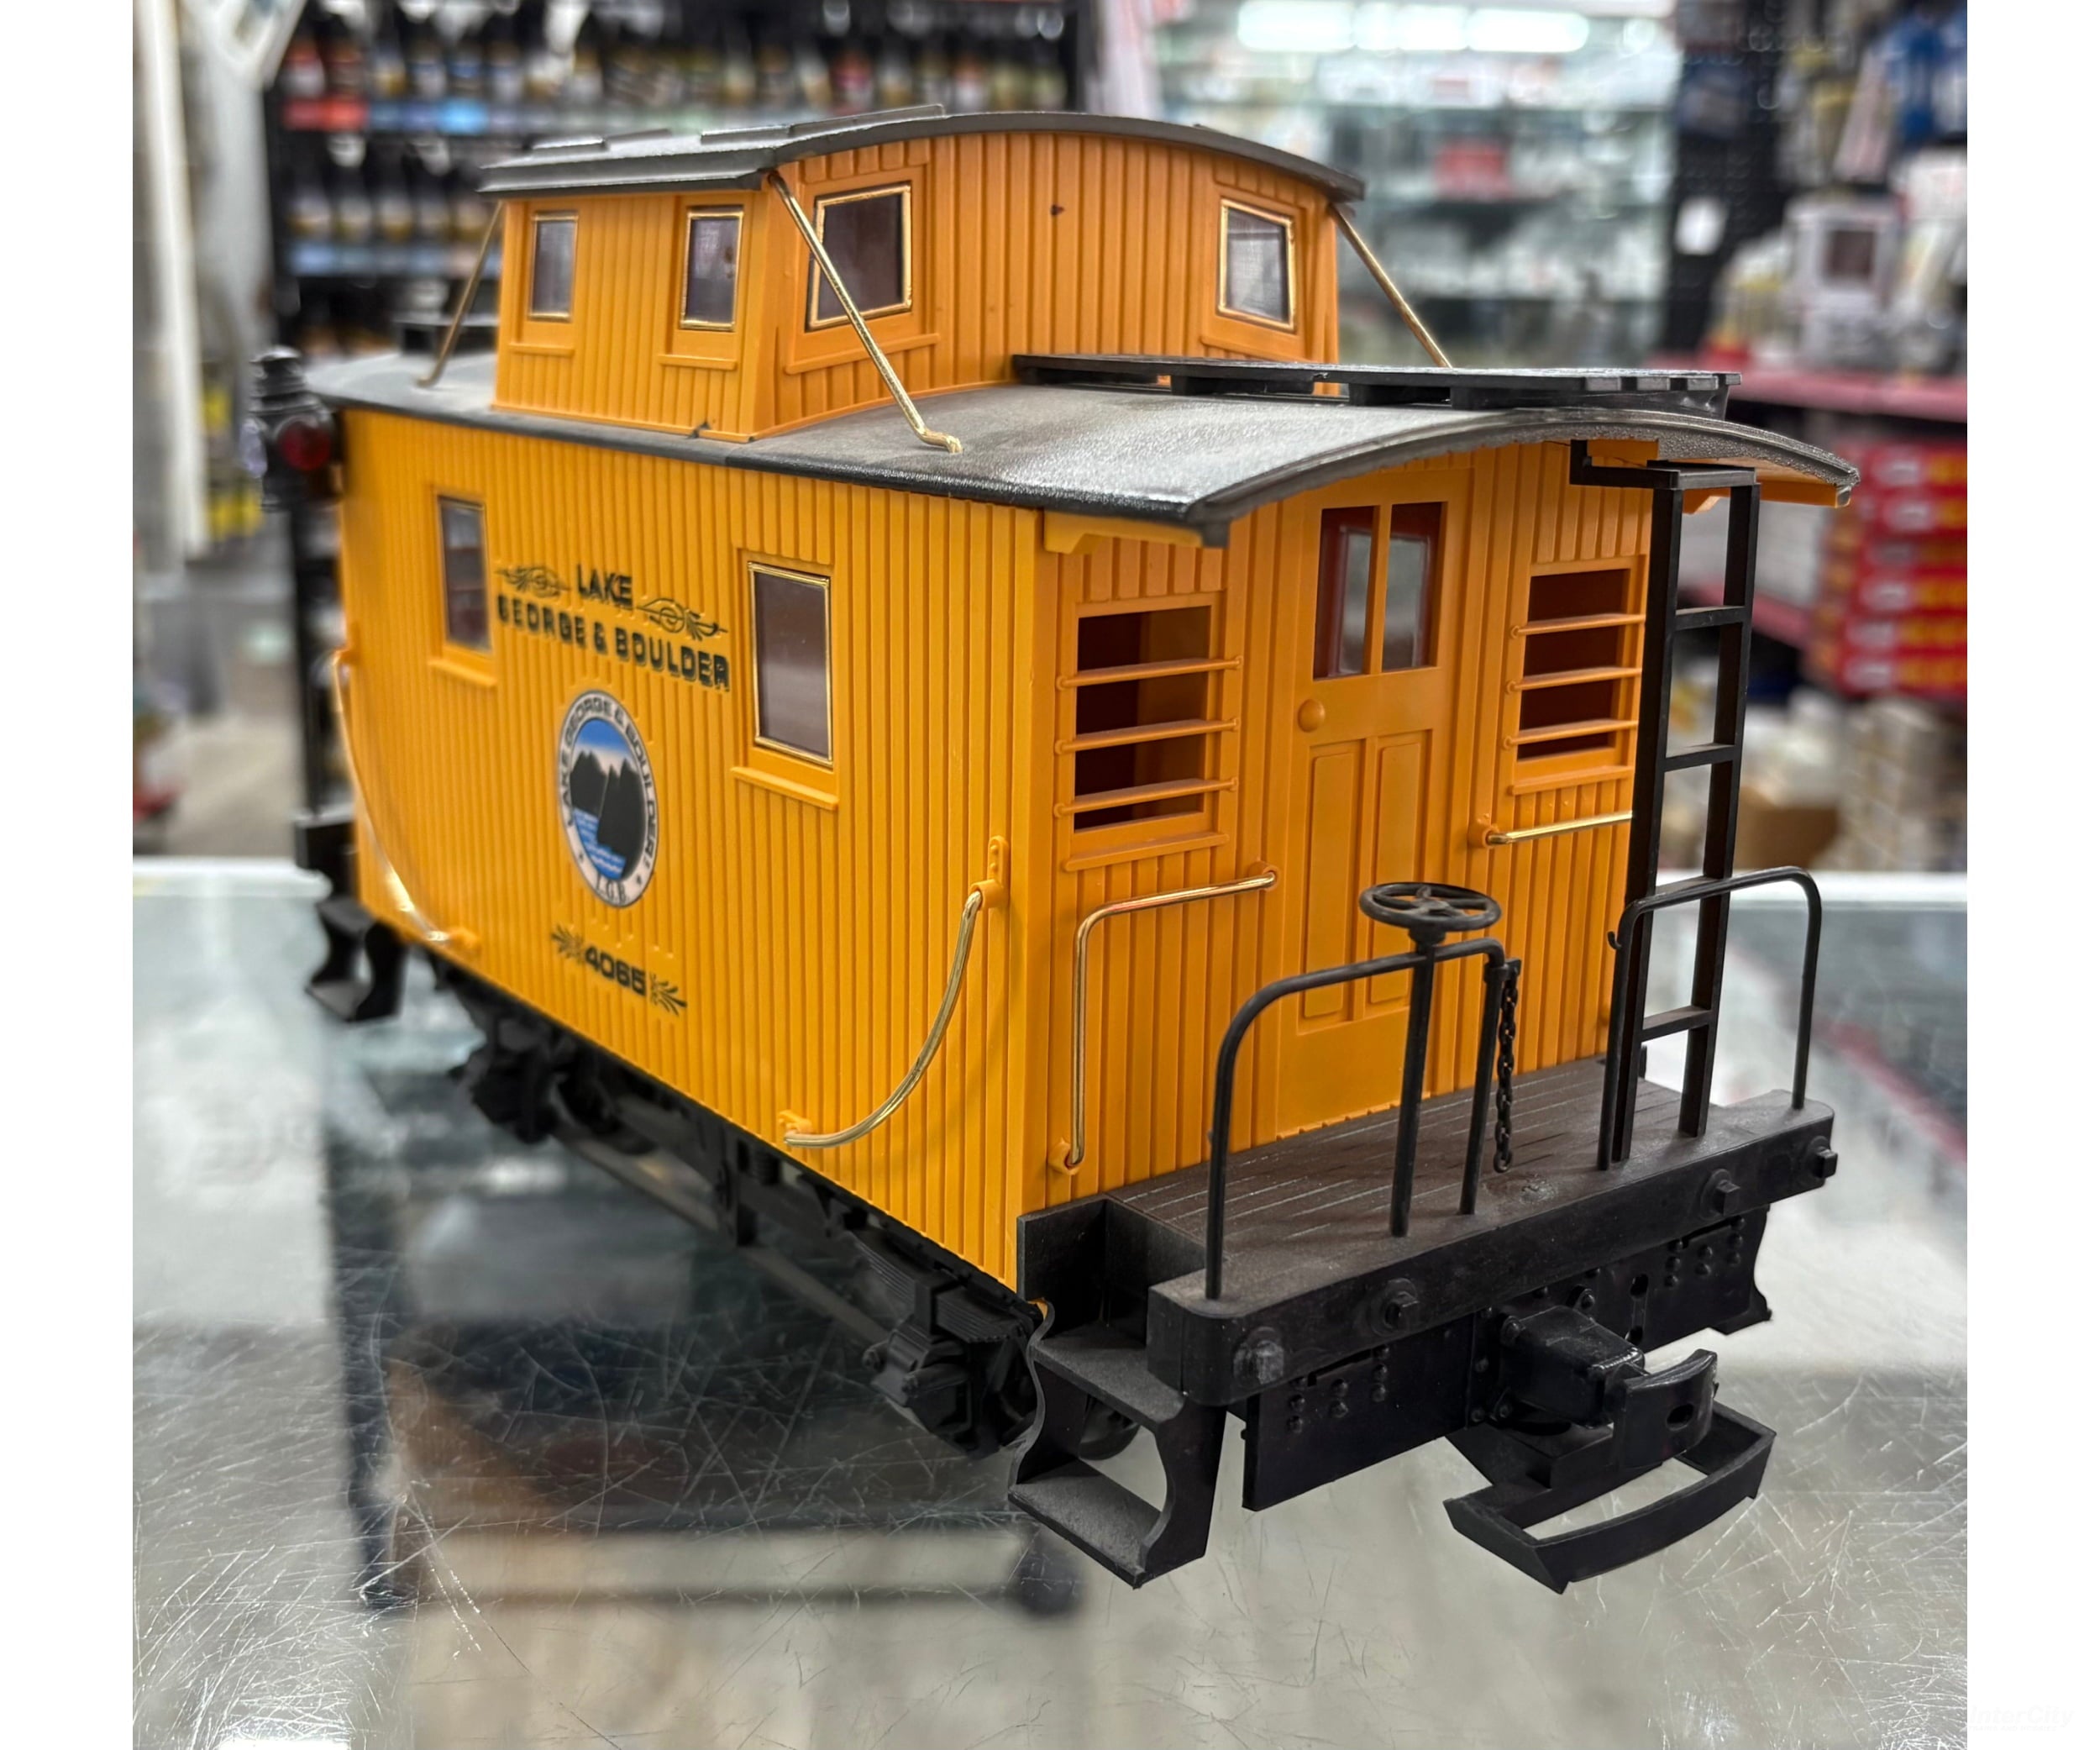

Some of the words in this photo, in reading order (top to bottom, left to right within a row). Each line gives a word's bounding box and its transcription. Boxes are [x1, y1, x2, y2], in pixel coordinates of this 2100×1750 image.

[577, 564, 633, 611] LAKE
[497, 594, 587, 649] GEORGE
[593, 621, 608, 655] &
[614, 627, 731, 692] BOULDER
[564, 696, 612, 747] GEORGE
[560, 749, 575, 828] LAKE
[625, 723, 656, 869] BOULDER
[584, 944, 648, 997] 4065
